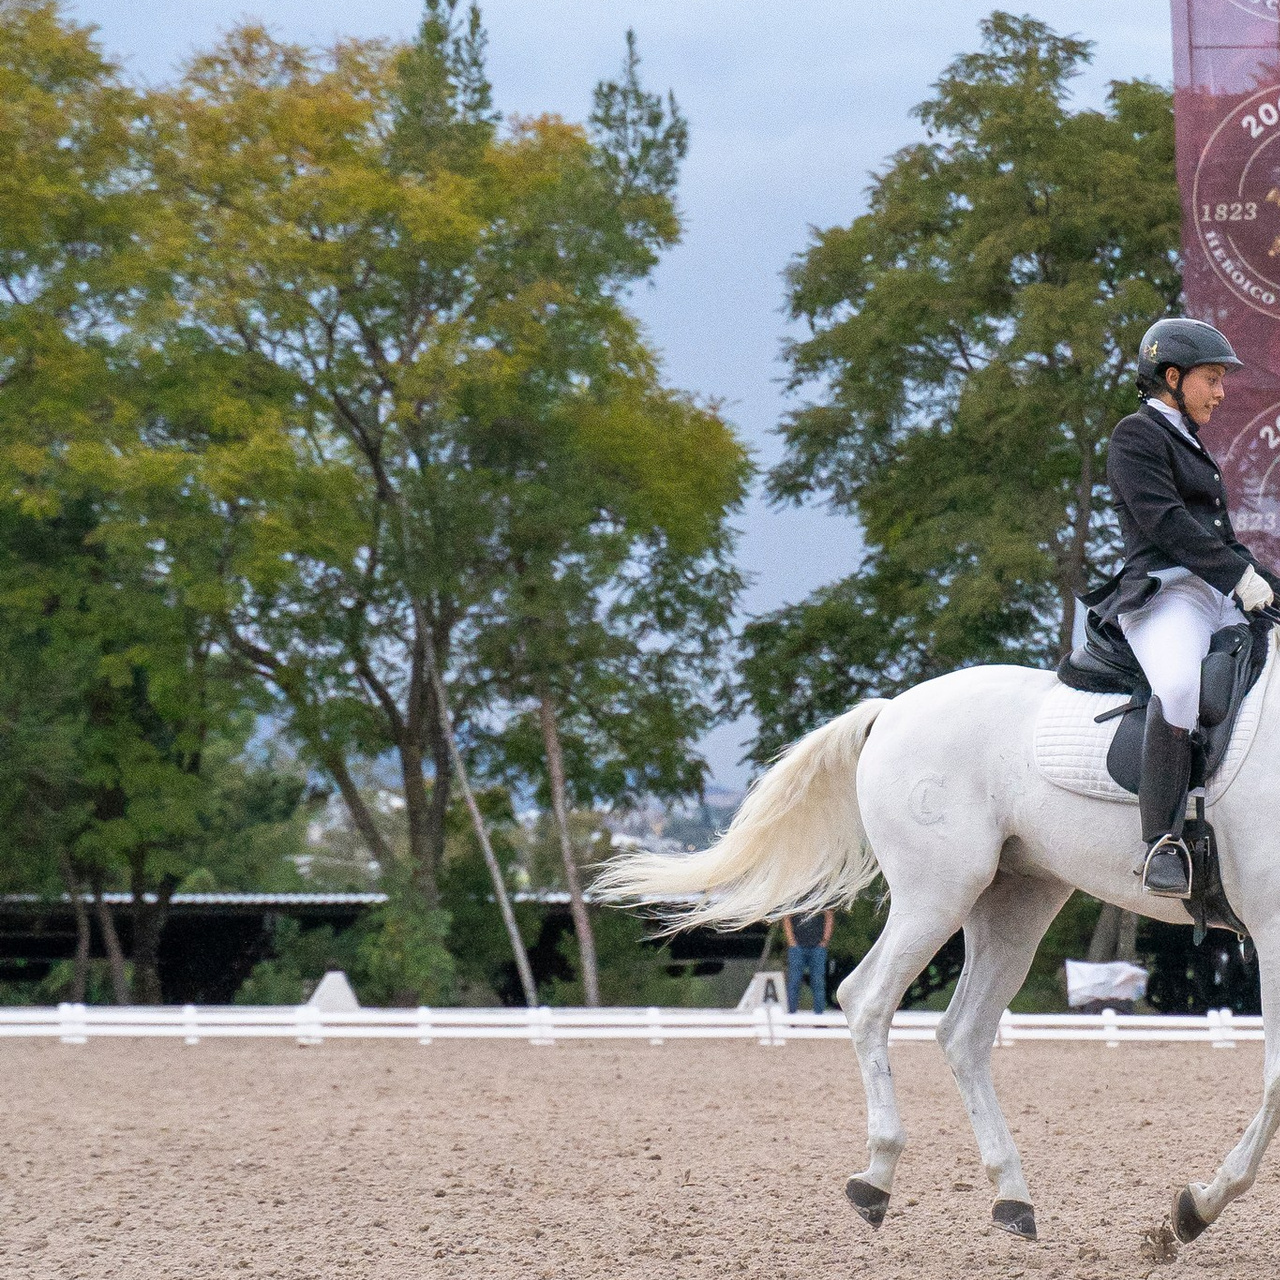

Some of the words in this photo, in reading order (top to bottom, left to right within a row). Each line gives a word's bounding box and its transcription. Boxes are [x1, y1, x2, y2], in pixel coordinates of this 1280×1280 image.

[1201, 202, 1258, 222] 1823
[1205, 230, 1276, 305] HEROICO
[1235, 512, 1277, 532] 823
[763, 978, 779, 1003] A
